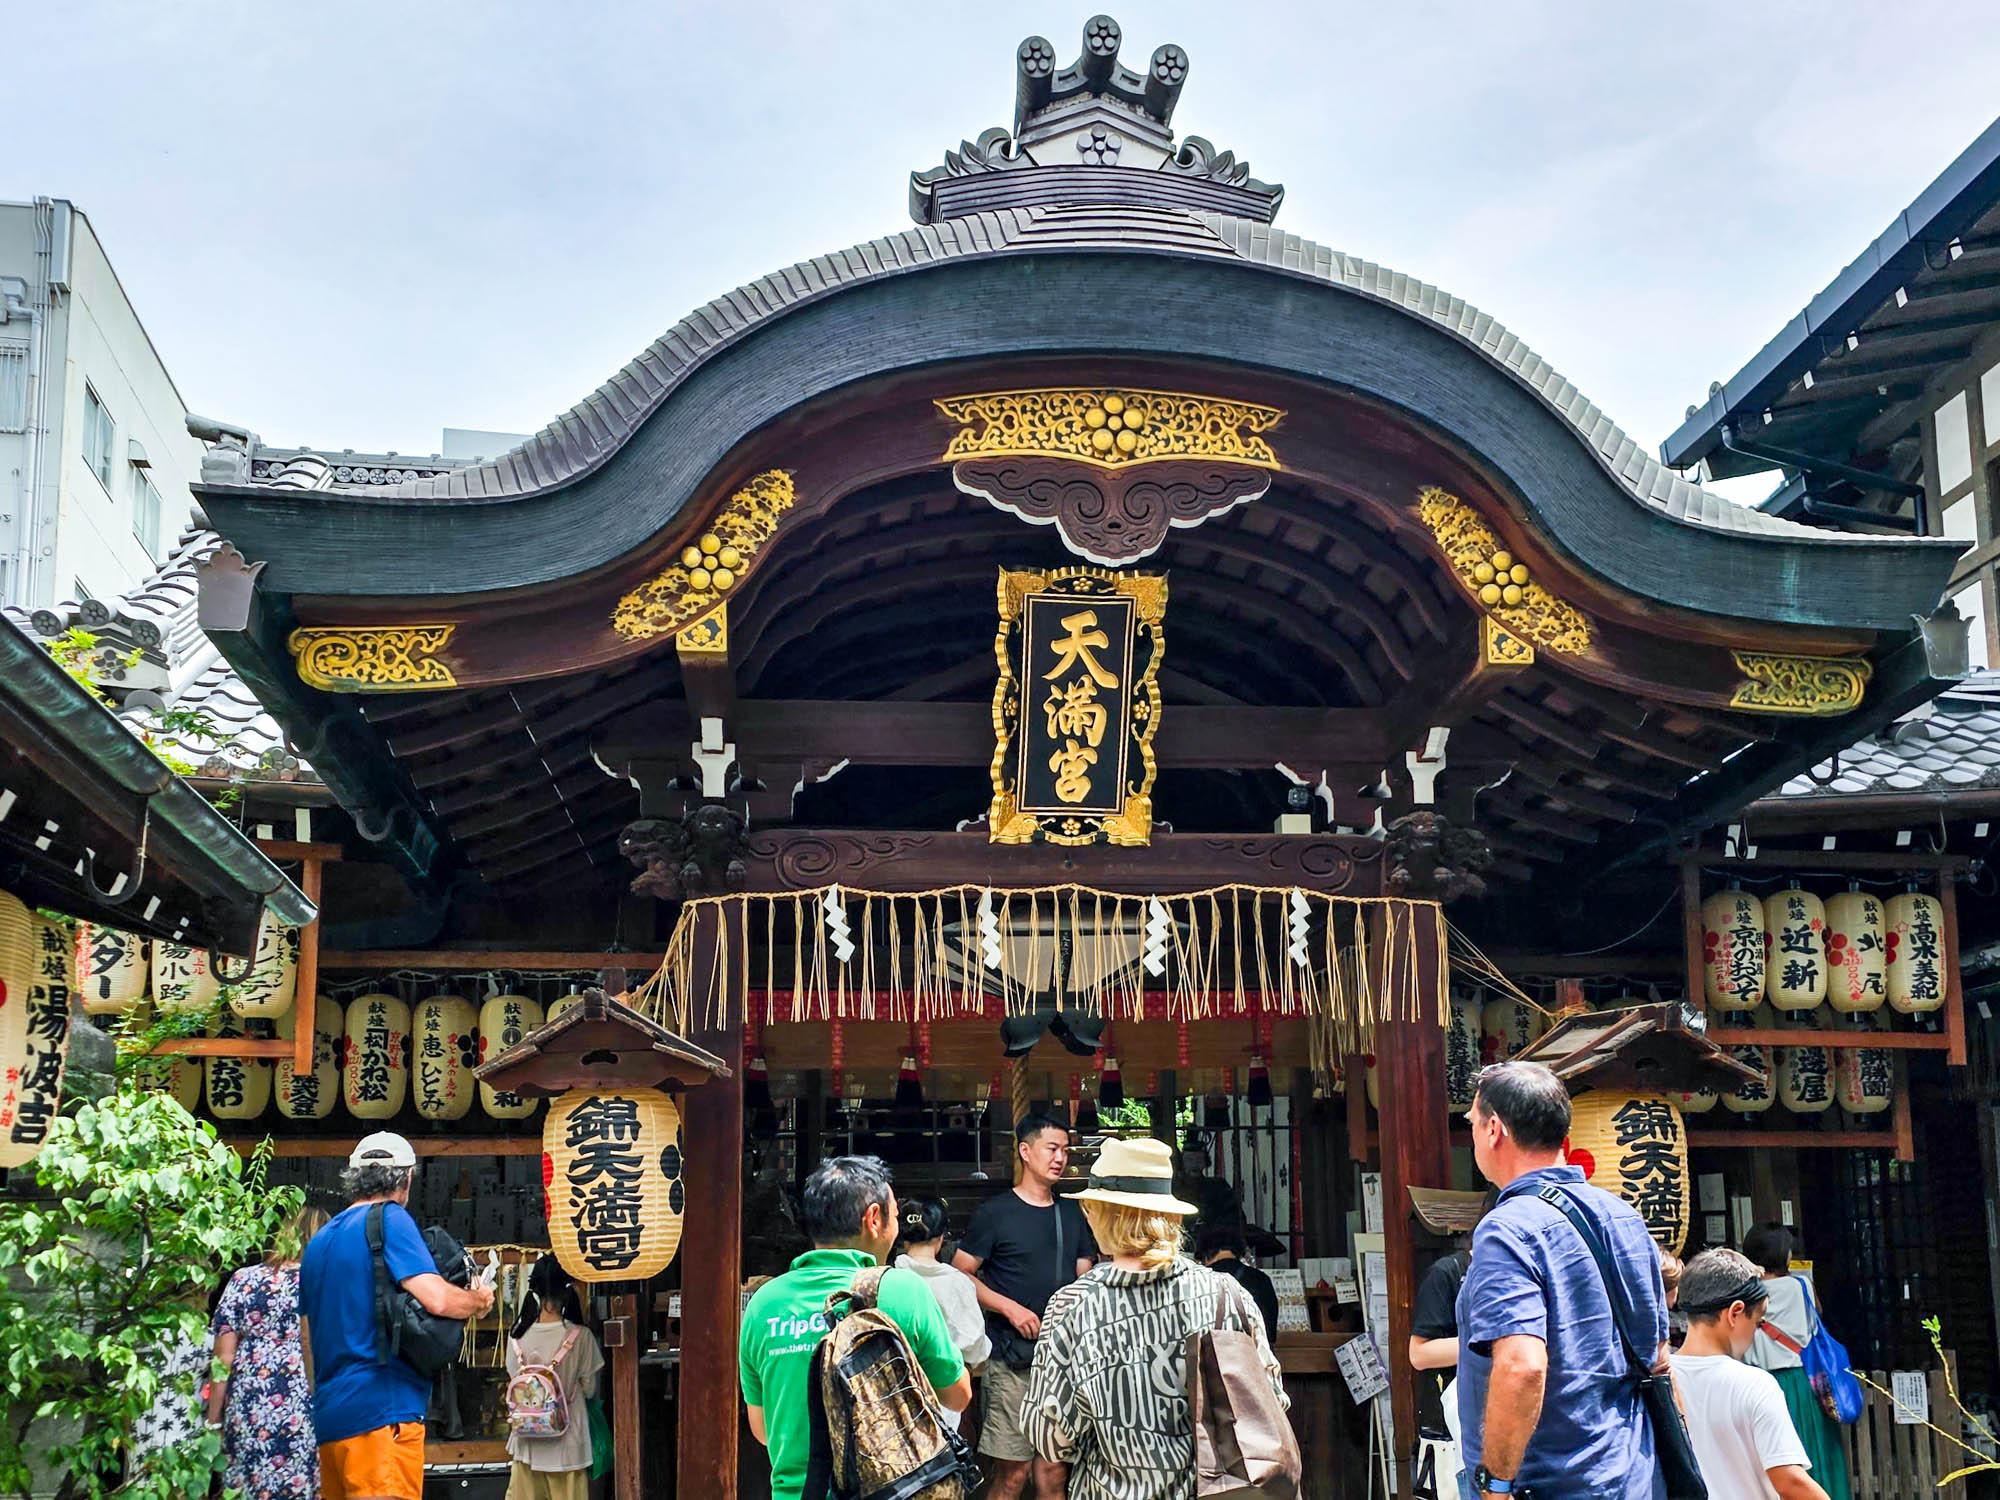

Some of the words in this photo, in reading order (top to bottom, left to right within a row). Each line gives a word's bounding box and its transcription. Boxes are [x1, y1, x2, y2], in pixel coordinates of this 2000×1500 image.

[1042, 609, 1119, 803] 天満宮
[565, 1095, 645, 1271] 錦天満宮
[767, 1312, 830, 1340] TripG
